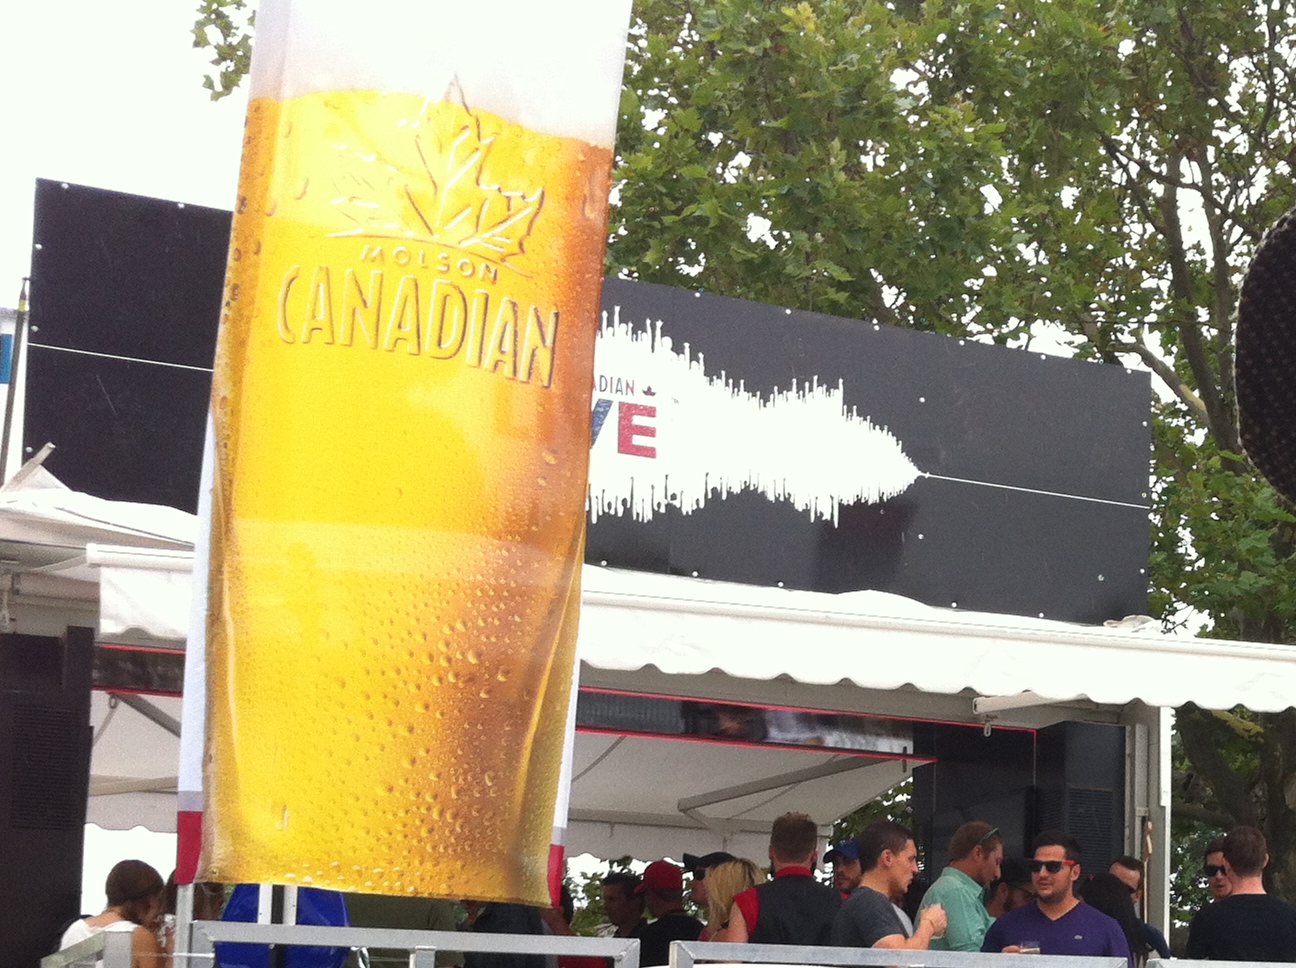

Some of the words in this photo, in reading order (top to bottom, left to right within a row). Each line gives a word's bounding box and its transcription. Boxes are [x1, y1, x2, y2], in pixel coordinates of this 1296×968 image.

[361, 243, 498, 286] MOLSON
[277, 264, 561, 389] CANADIAN
[593, 374, 634, 397] DIAN
